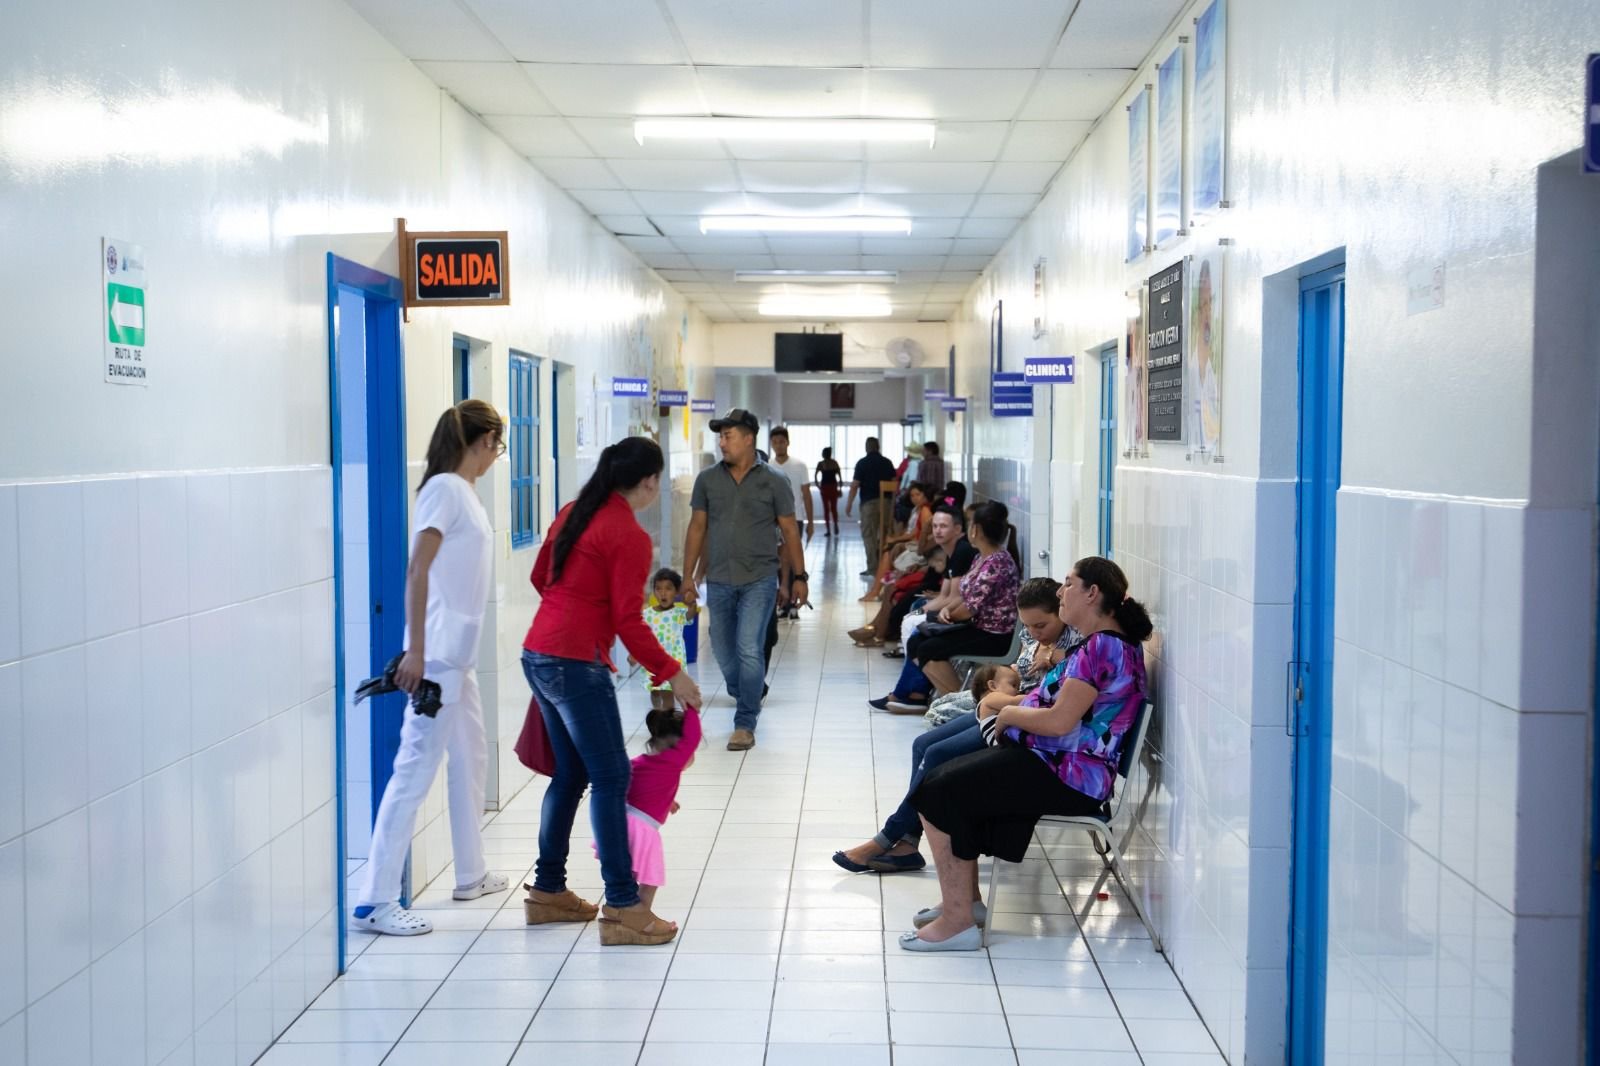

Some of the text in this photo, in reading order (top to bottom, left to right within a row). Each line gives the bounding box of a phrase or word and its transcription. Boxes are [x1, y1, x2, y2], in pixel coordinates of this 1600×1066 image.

[420, 253, 498, 286] SALIDA
[115, 347, 142, 361] RUTA DE
[108, 363, 146, 378] EVACUACION
[1025, 363, 1073, 376] CLINICA 1
[613, 382, 648, 393] CLINICA 2
